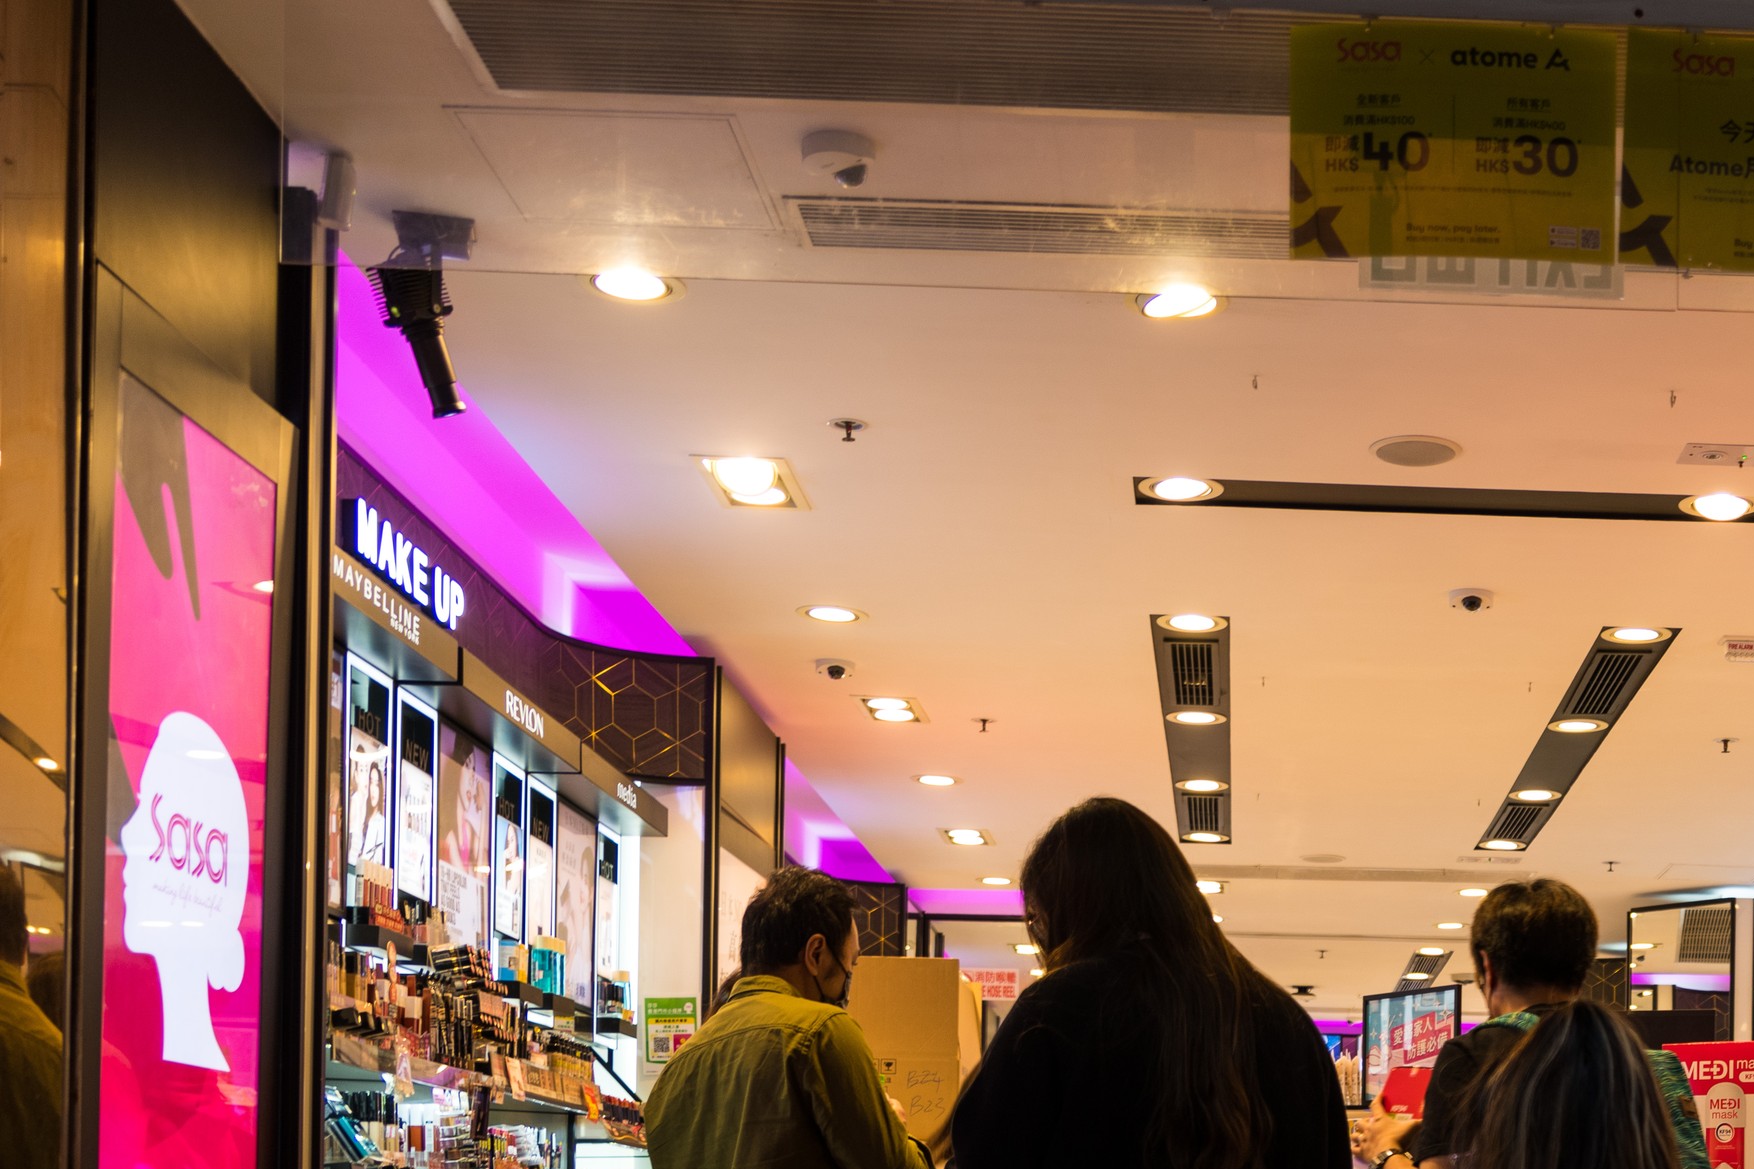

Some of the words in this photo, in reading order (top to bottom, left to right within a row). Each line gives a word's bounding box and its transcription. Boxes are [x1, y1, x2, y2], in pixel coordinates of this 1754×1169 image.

[1451, 47, 1538, 69] atome
[1325, 159, 1359, 172] HK$
[1475, 159, 1509, 173] HK$
[1406, 223, 1424, 233] Buy
[1453, 225, 1472, 235] pay
[1734, 239, 1751, 249] Buy
[355, 498, 430, 608] MAKE
[433, 564, 465, 630] UP
[333, 554, 421, 636] MAYBELLINE
[357, 708, 381, 734] HOT
[505, 689, 545, 739] REVLON
[404, 739, 429, 771] NEW
[1711, 1110, 1738, 1119] mask
